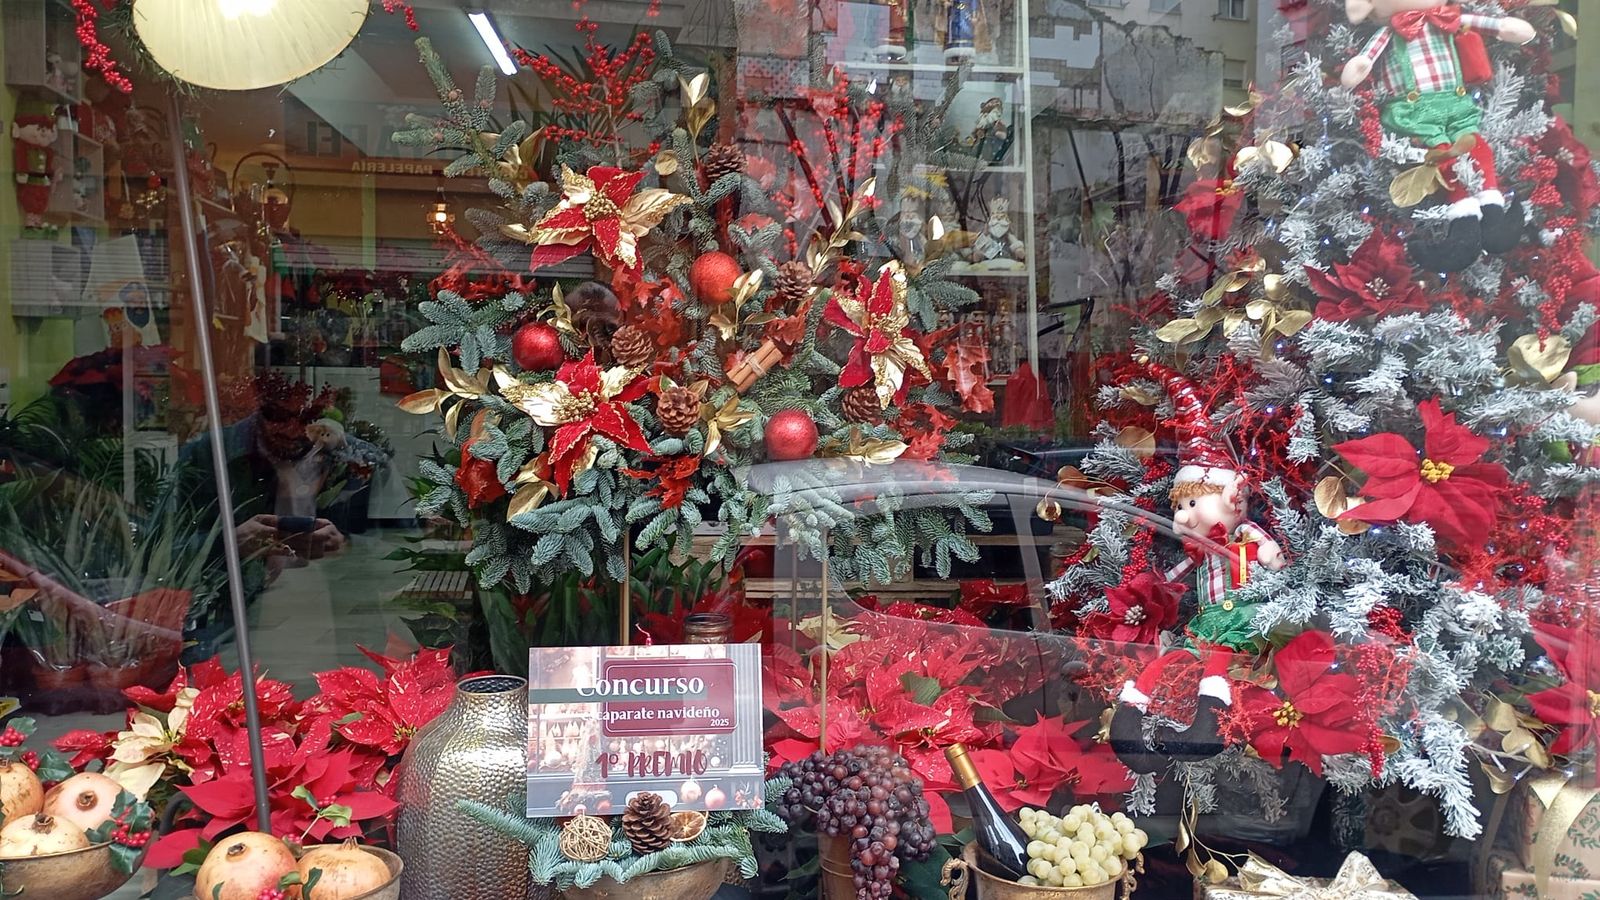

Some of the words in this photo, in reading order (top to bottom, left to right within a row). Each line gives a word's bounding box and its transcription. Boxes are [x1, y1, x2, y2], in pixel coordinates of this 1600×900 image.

[576, 674, 704, 697] Concurso
[582, 707, 654, 724] ecaparate
[657, 705, 720, 720] navideño
[710, 718, 729, 727] 2025
[628, 749, 708, 778] PREMIO
